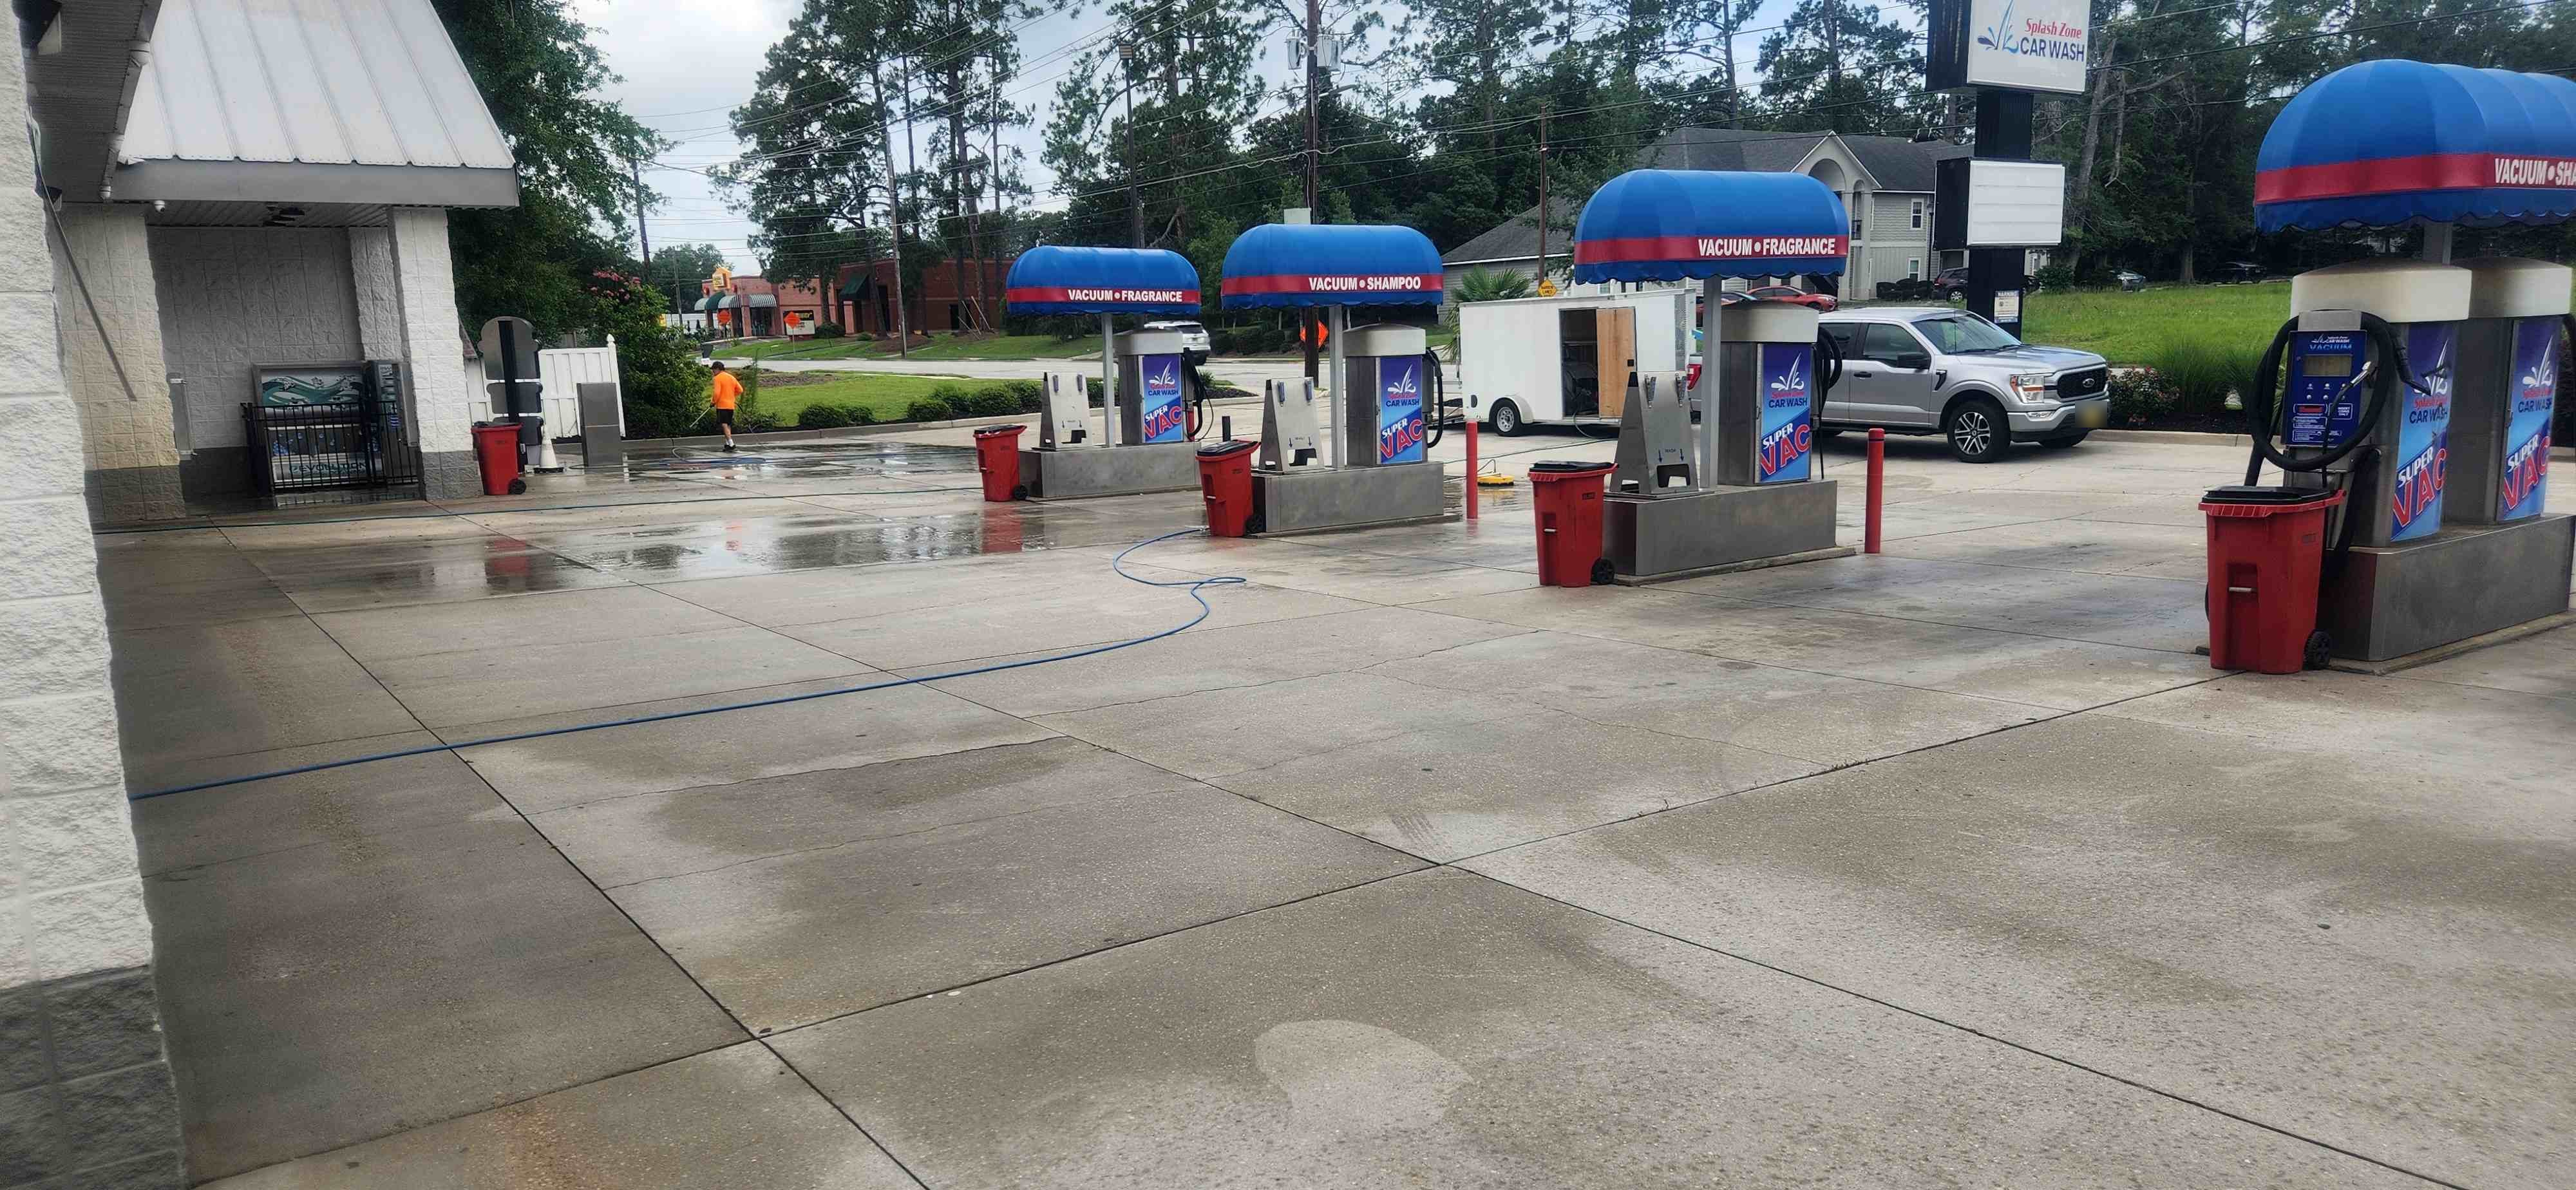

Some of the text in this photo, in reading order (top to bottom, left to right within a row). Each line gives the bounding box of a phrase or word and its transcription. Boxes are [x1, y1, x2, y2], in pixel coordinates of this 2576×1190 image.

[2025, 18, 2081, 39] Splash Zone
[2020, 37, 2085, 62] CAR WASH
[2494, 158, 2548, 185] VACUUM
[1698, 238, 1835, 256] VACUUM FRAGRANCE
[1068, 289, 1182, 302] VACUUM FRAGRANCE
[1309, 276, 1421, 290] VACUUM SHAMPOO
[1145, 405, 1168, 422] SUPER
[1769, 397, 1807, 408] CAR WASH
[2518, 401, 2534, 413] CAR
[1144, 406, 1181, 439] VAC
[1382, 418, 1408, 439] SUPER
[2409, 410, 2427, 424] CAR
[1381, 419, 1422, 458] VAC
[1763, 422, 1794, 449] SUPER
[1760, 424, 1810, 475] VAC
[2507, 433, 2539, 473] SUPER
[2398, 446, 2434, 488] SUPER
[2503, 435, 2551, 510] VAC
[2392, 448, 2447, 528] VAC
